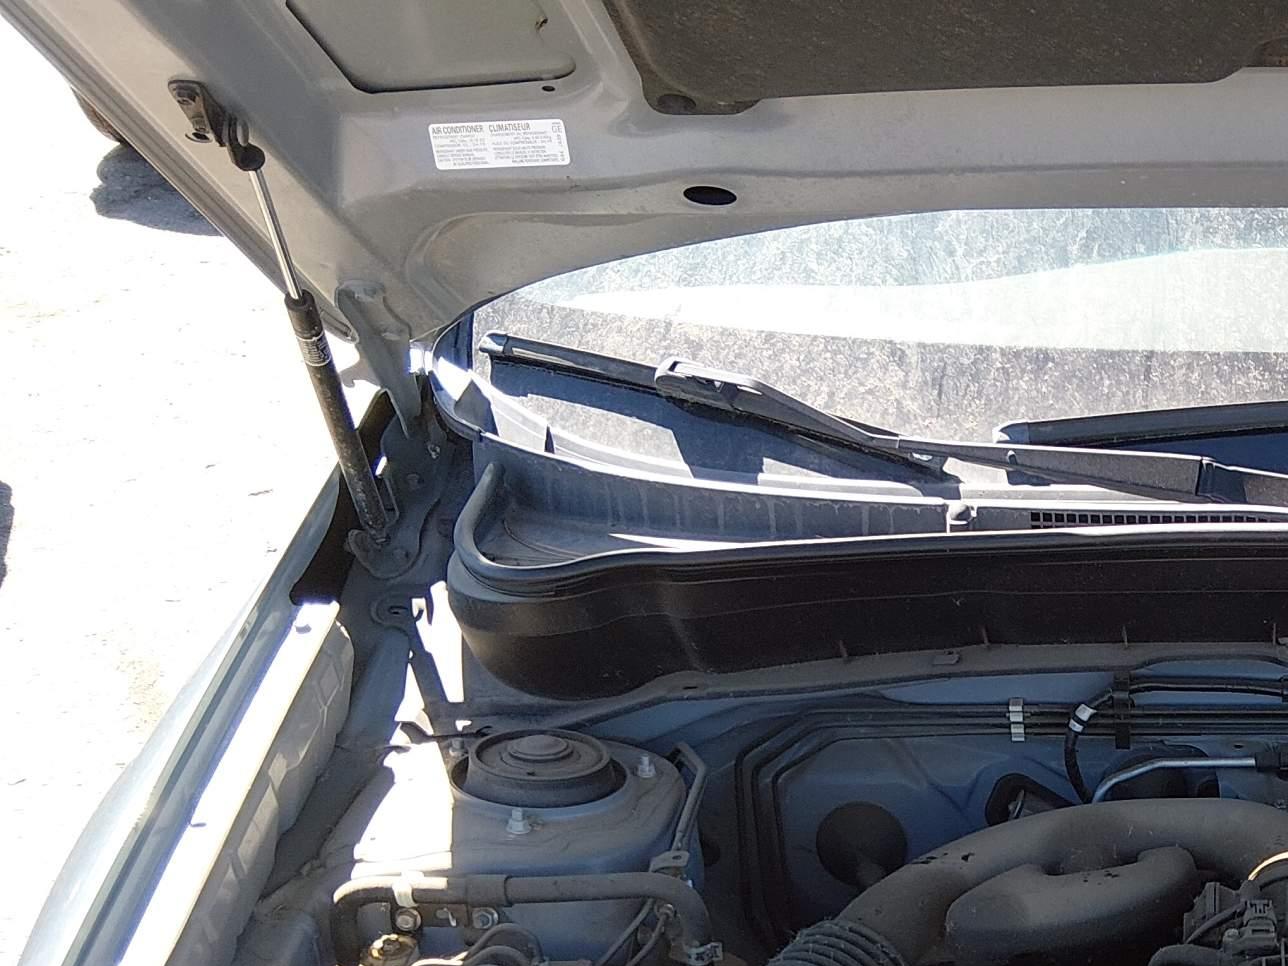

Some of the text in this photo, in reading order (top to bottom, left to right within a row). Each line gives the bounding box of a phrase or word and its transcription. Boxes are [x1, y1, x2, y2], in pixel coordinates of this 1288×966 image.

[431, 126, 443, 135] AIR
[443, 124, 484, 134] CONDITIONER
[488, 123, 531, 132] CLIMATISEUR
